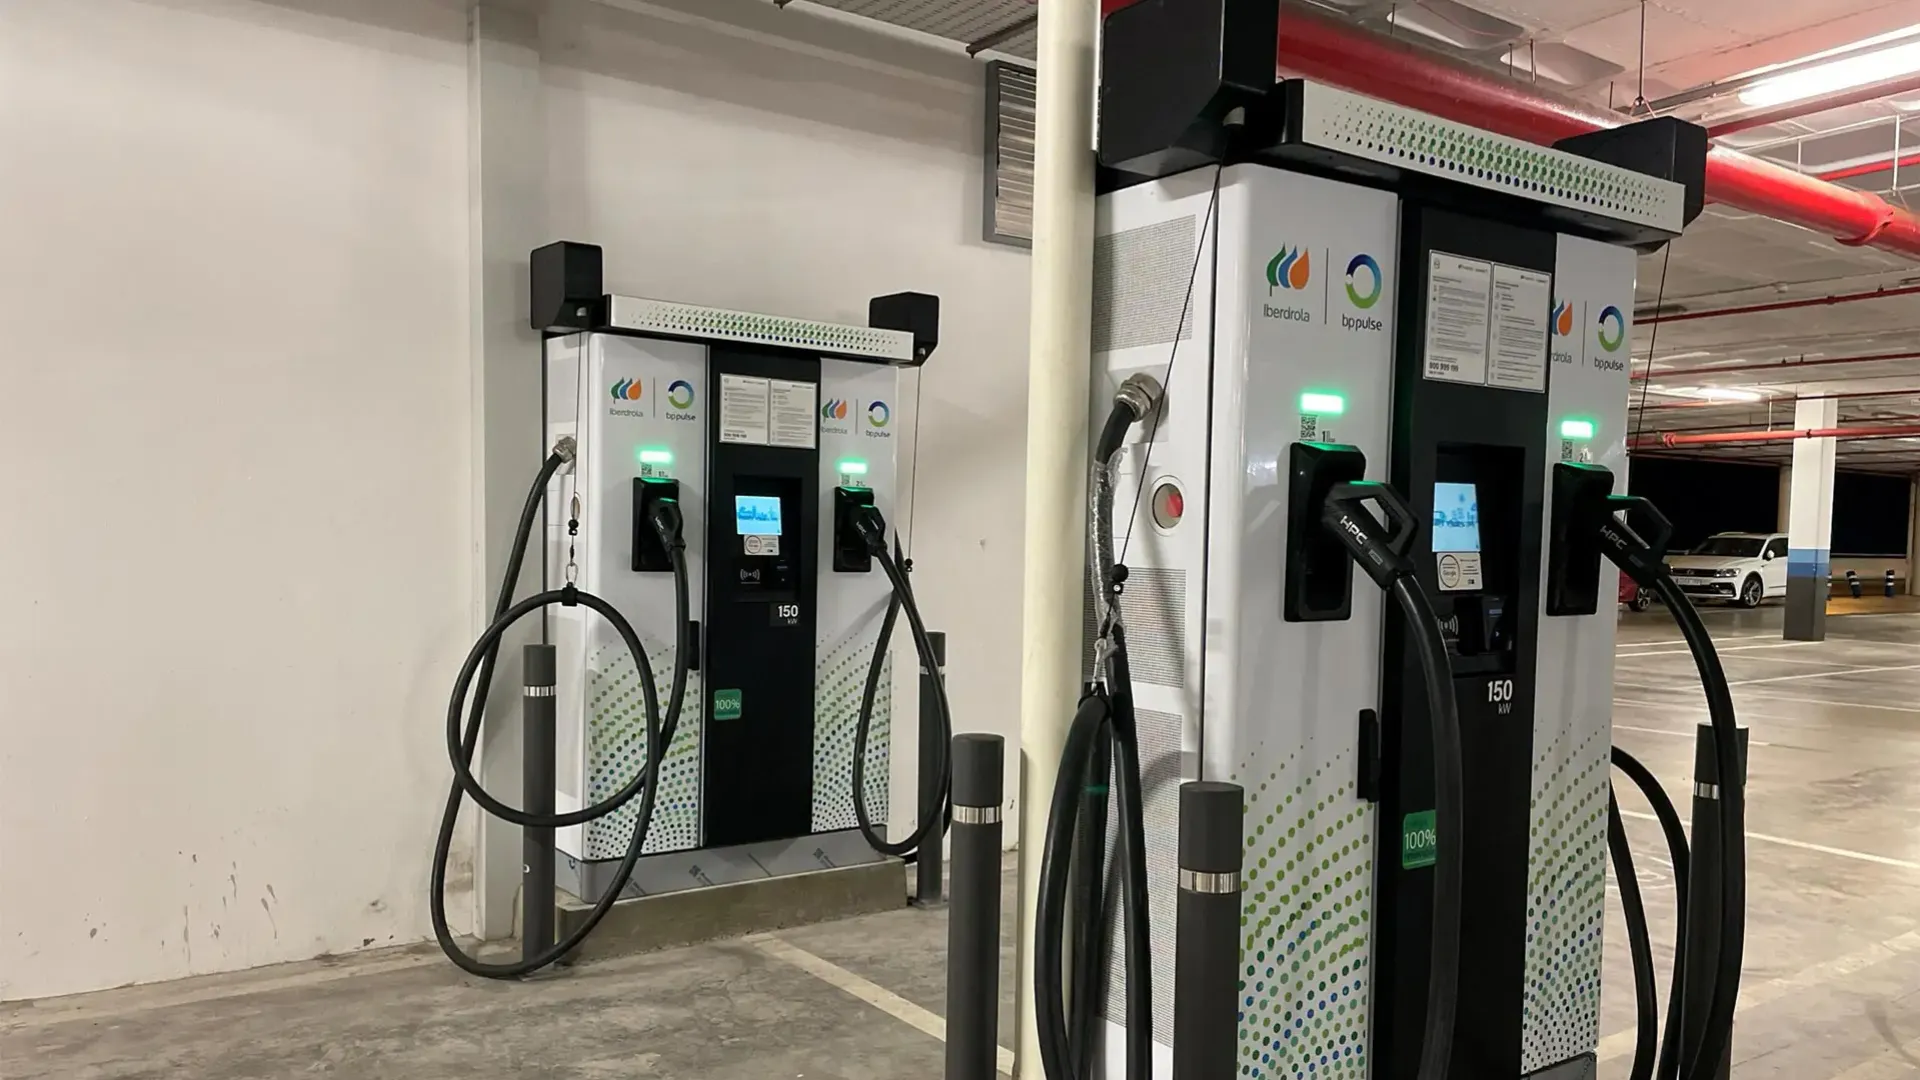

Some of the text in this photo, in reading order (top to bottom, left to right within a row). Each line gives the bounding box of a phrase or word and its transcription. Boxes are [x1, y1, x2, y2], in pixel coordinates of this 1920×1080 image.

[1263, 304, 1310, 322] Iberdrola
[609, 403, 644, 417] Iberdrola
[1340, 515, 1368, 545] HPC
[1600, 525, 1628, 550] HPC
[778, 604, 799, 618] 150
[1487, 679, 1513, 702] 150
[715, 699, 740, 710] 100%
[1498, 702, 1512, 715] kW
[1405, 828, 1436, 850] 100%
